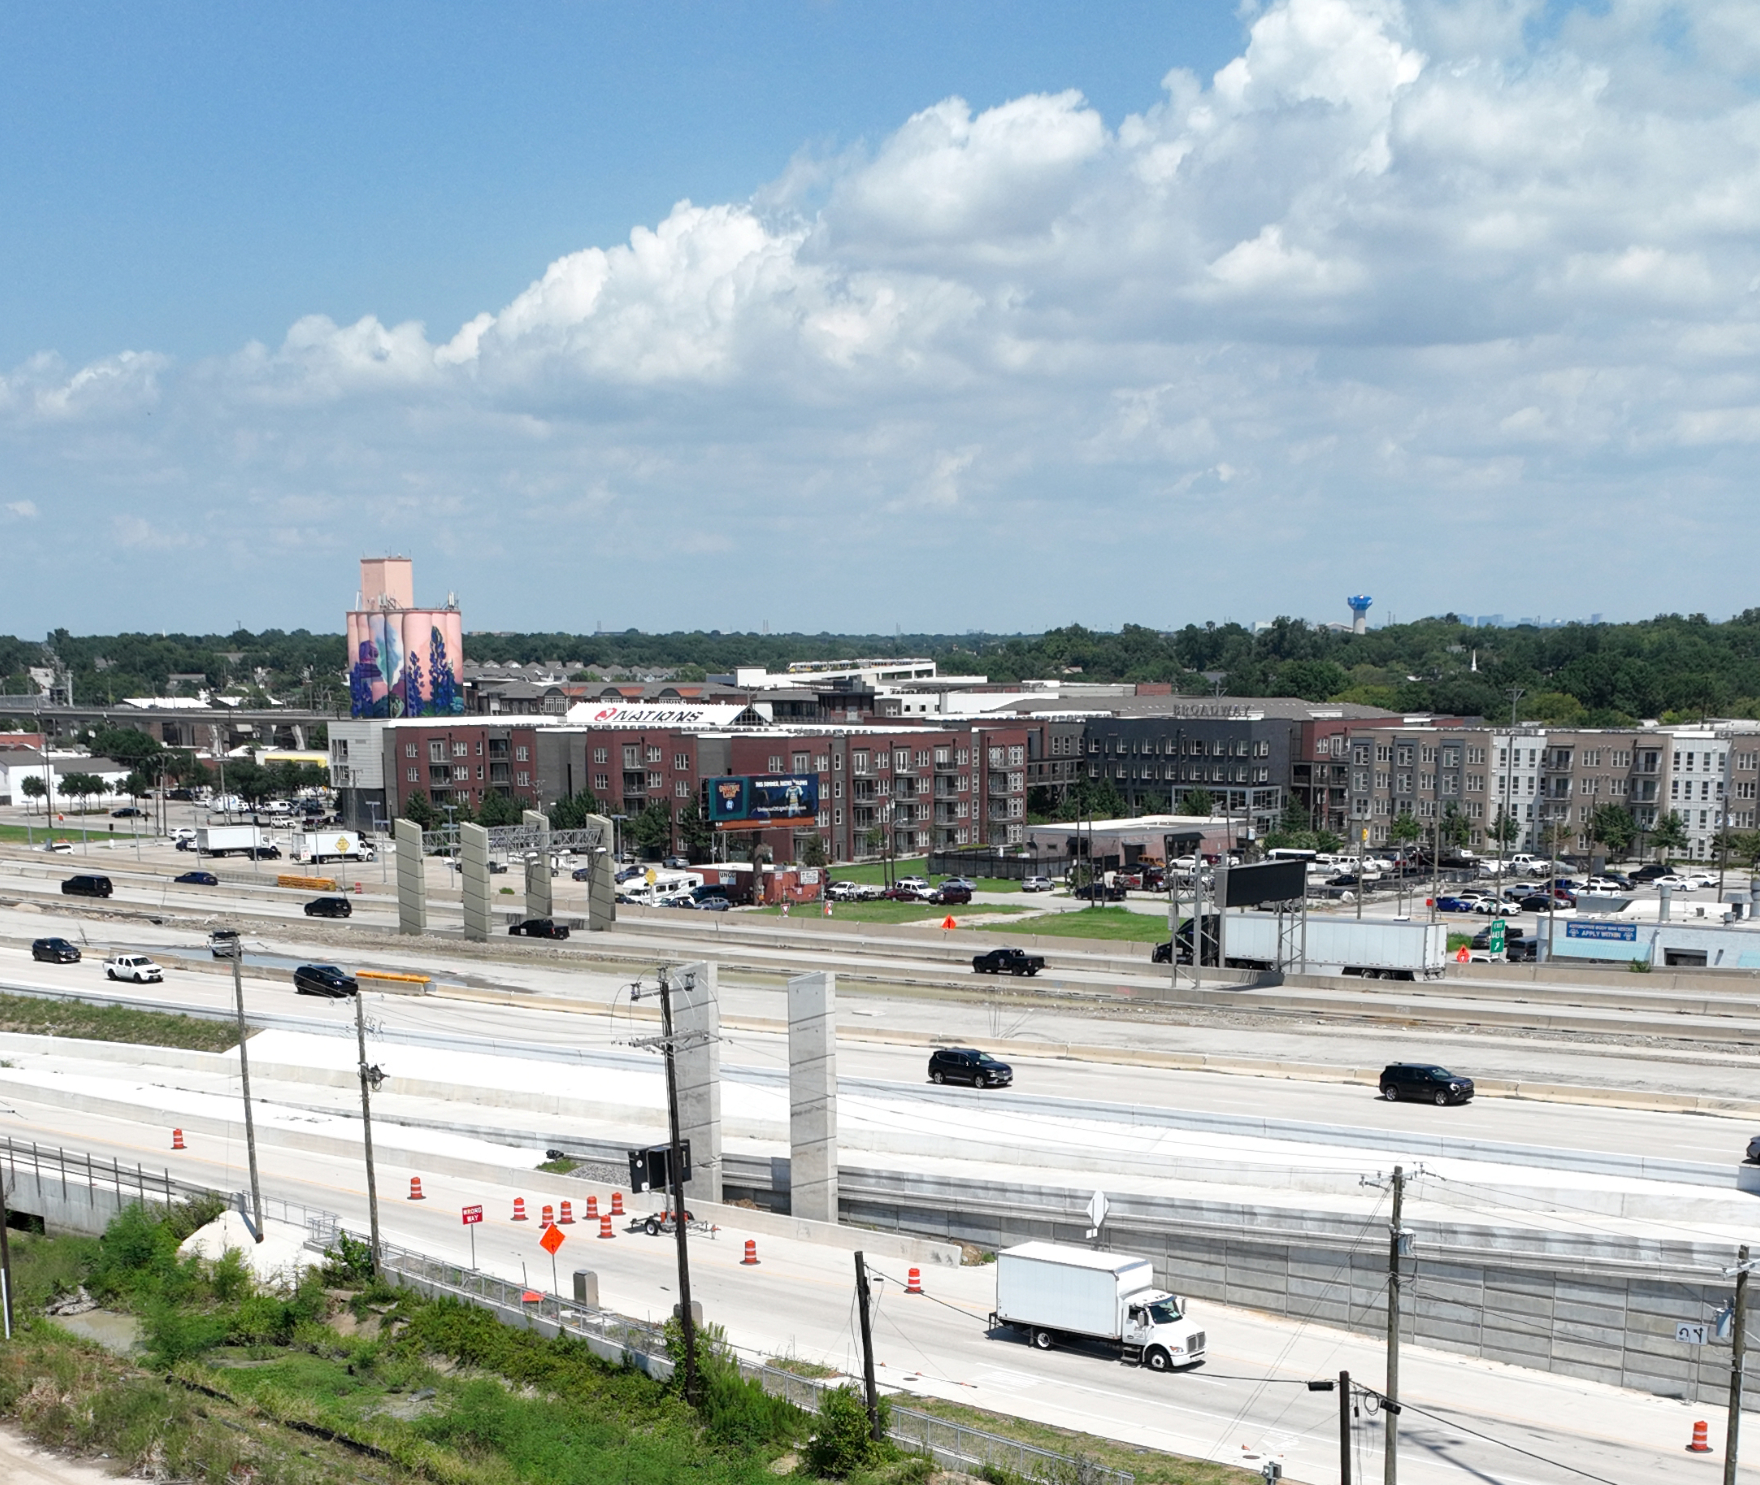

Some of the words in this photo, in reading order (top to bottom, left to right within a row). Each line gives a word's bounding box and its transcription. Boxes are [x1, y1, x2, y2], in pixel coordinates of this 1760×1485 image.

[612, 710, 704, 723] NATIONS
[1173, 704, 1250, 717] BROADWAY
[463, 1206, 482, 1215] WRONG
